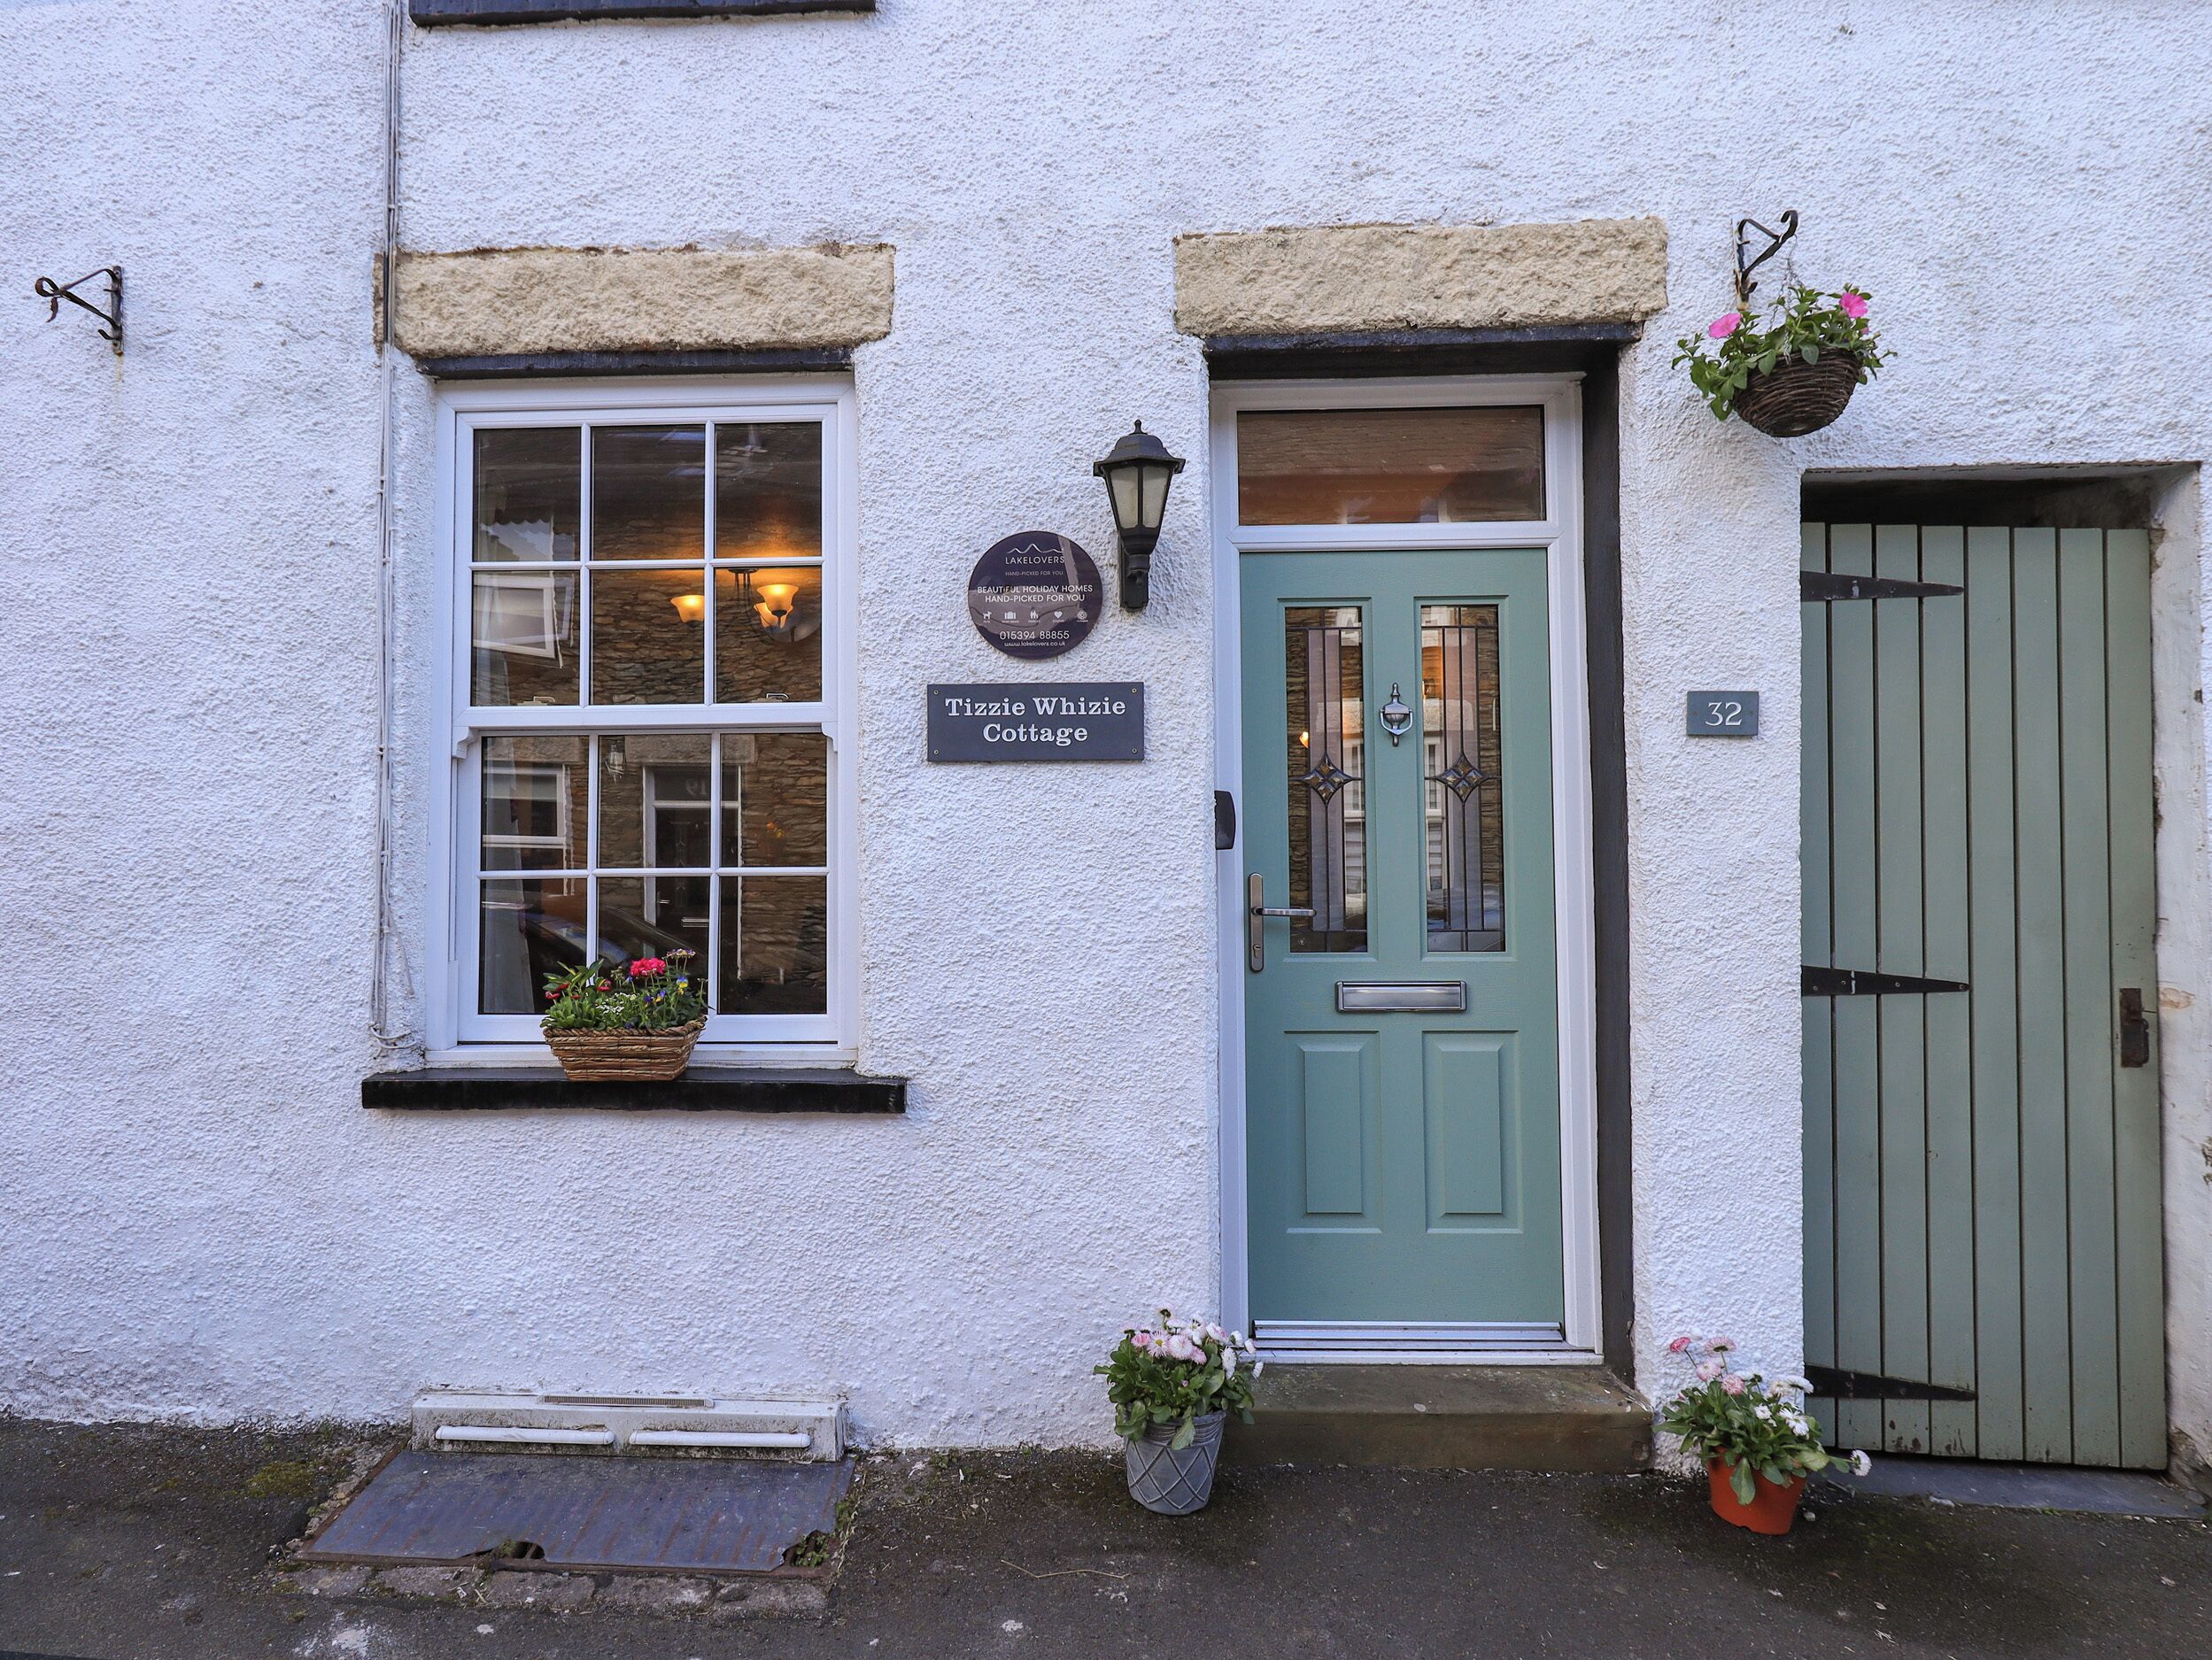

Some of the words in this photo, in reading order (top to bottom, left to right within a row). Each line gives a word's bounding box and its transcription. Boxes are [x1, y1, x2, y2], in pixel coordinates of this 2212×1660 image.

[1005, 556, 1065, 565] LAKELOVERS
[999, 631, 1035, 640] 015394
[1039, 630, 1070, 640] 88855
[945, 697, 1025, 716] Tizzie
[1032, 696, 1126, 715] Whizie
[1705, 701, 1743, 726] 32
[982, 722, 1088, 746] Cottage
